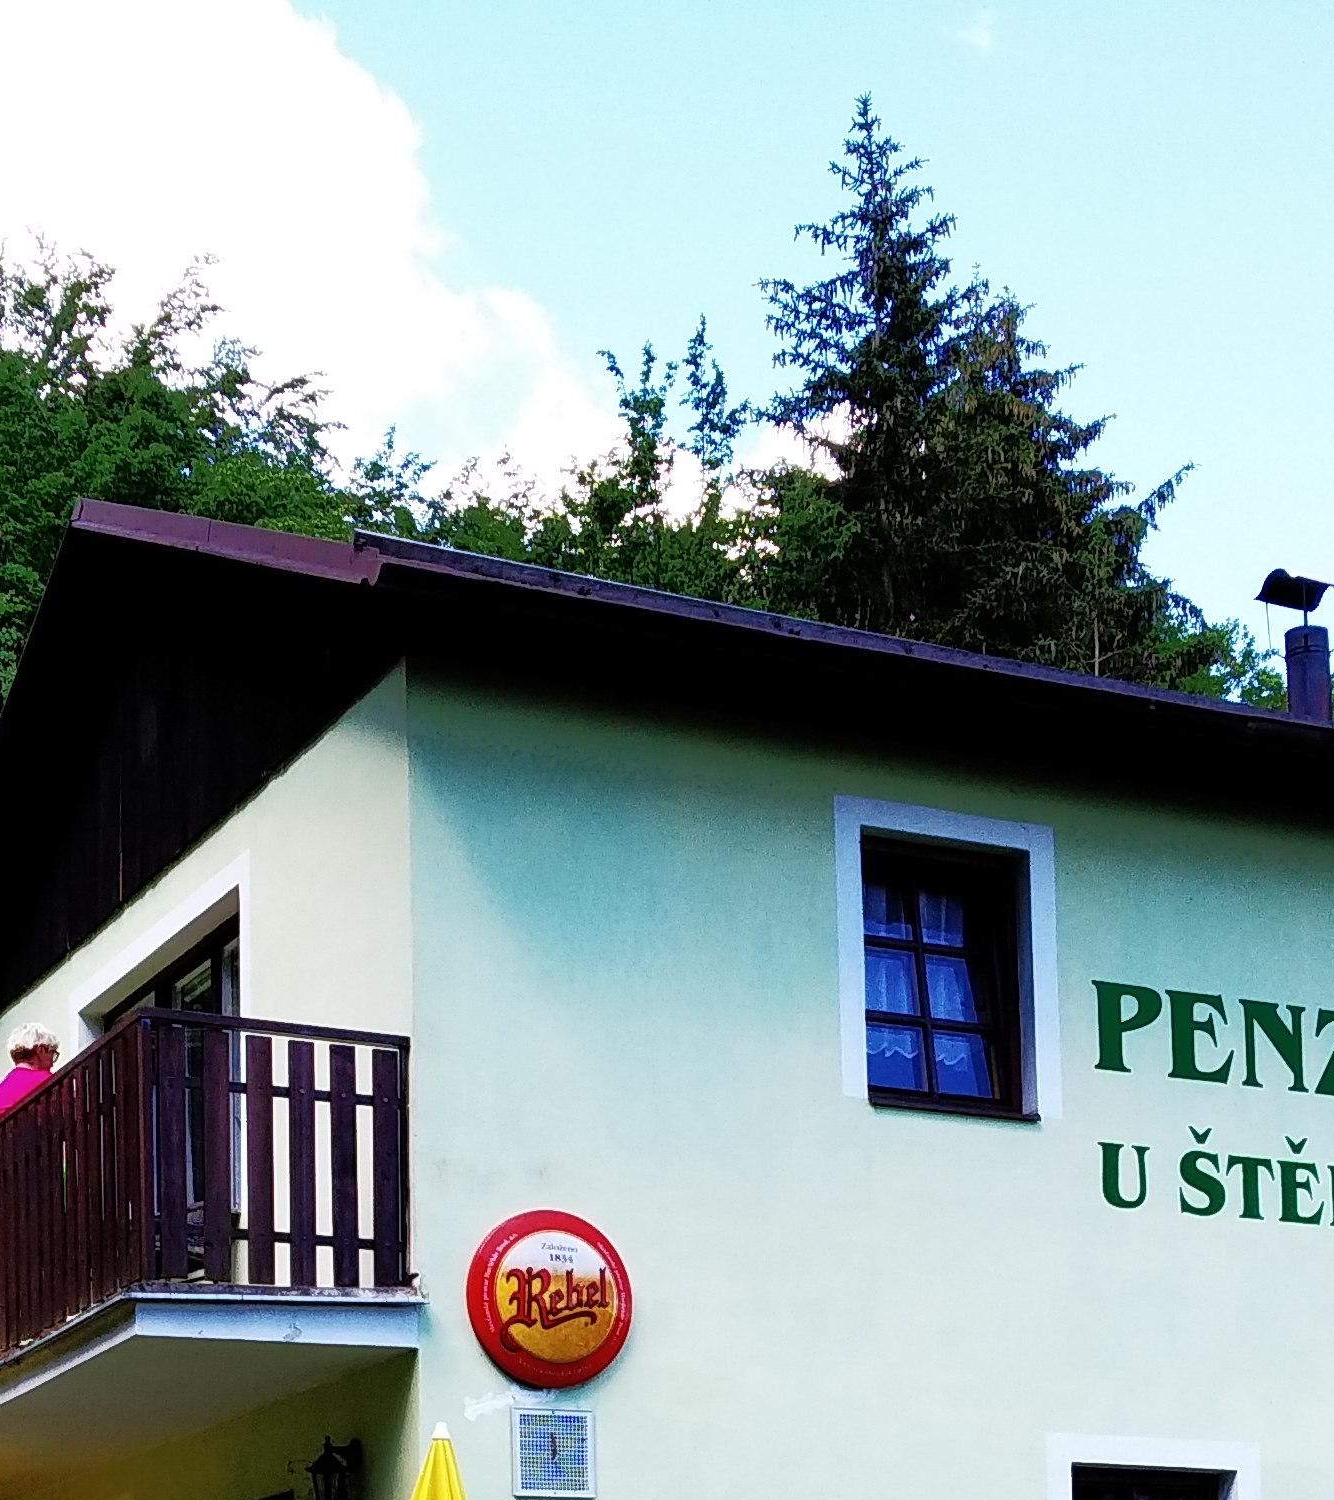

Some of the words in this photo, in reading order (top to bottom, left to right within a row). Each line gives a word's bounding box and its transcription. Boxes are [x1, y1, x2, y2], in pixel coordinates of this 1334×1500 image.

[1098, 1142, 1150, 1209] U
[550, 1254, 573, 1263] 1834
[500, 1267, 609, 1352] Rebel
